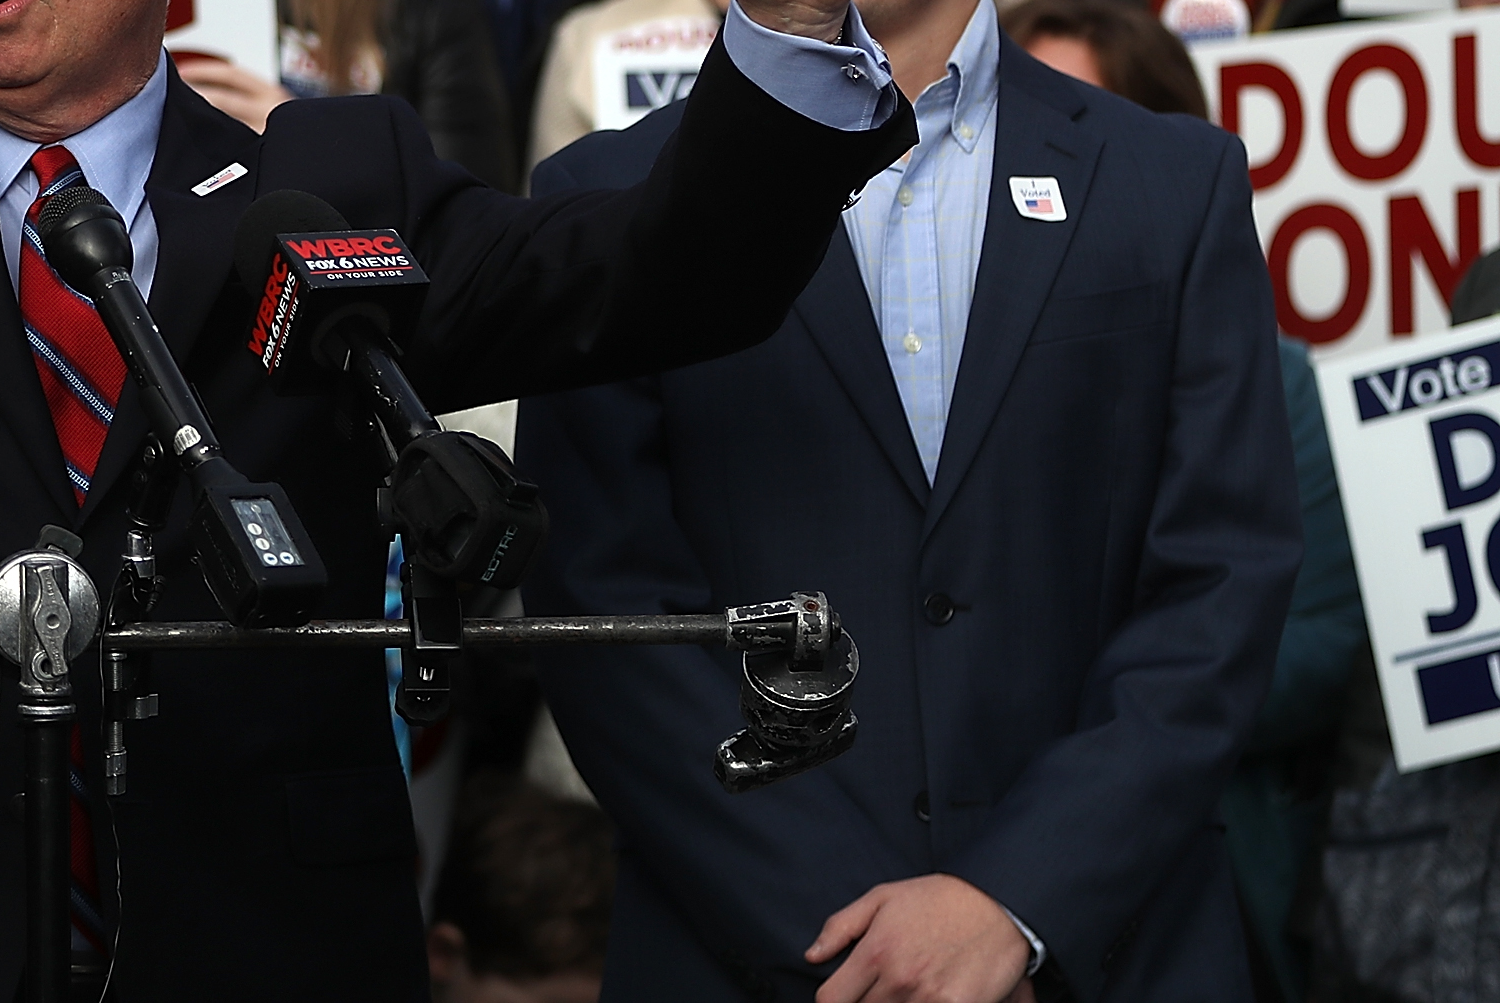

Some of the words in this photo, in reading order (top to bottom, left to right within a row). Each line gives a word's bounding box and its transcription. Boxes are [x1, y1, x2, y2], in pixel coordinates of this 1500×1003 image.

[1220, 34, 1500, 192] DOU
[286, 236, 402, 258] WBRC
[305, 259, 340, 271] FOX
[339, 257, 354, 269] 6
[354, 255, 410, 268] NEWS
[346, 271, 376, 279] YOUR
[247, 252, 288, 356] WBRC
[275, 271, 297, 326] NEWS
[271, 322, 280, 339] 6
[274, 351, 282, 368] ON
[279, 323, 292, 350] YOUR
[262, 336, 277, 369] FOX
[1366, 355, 1491, 414] Vote
